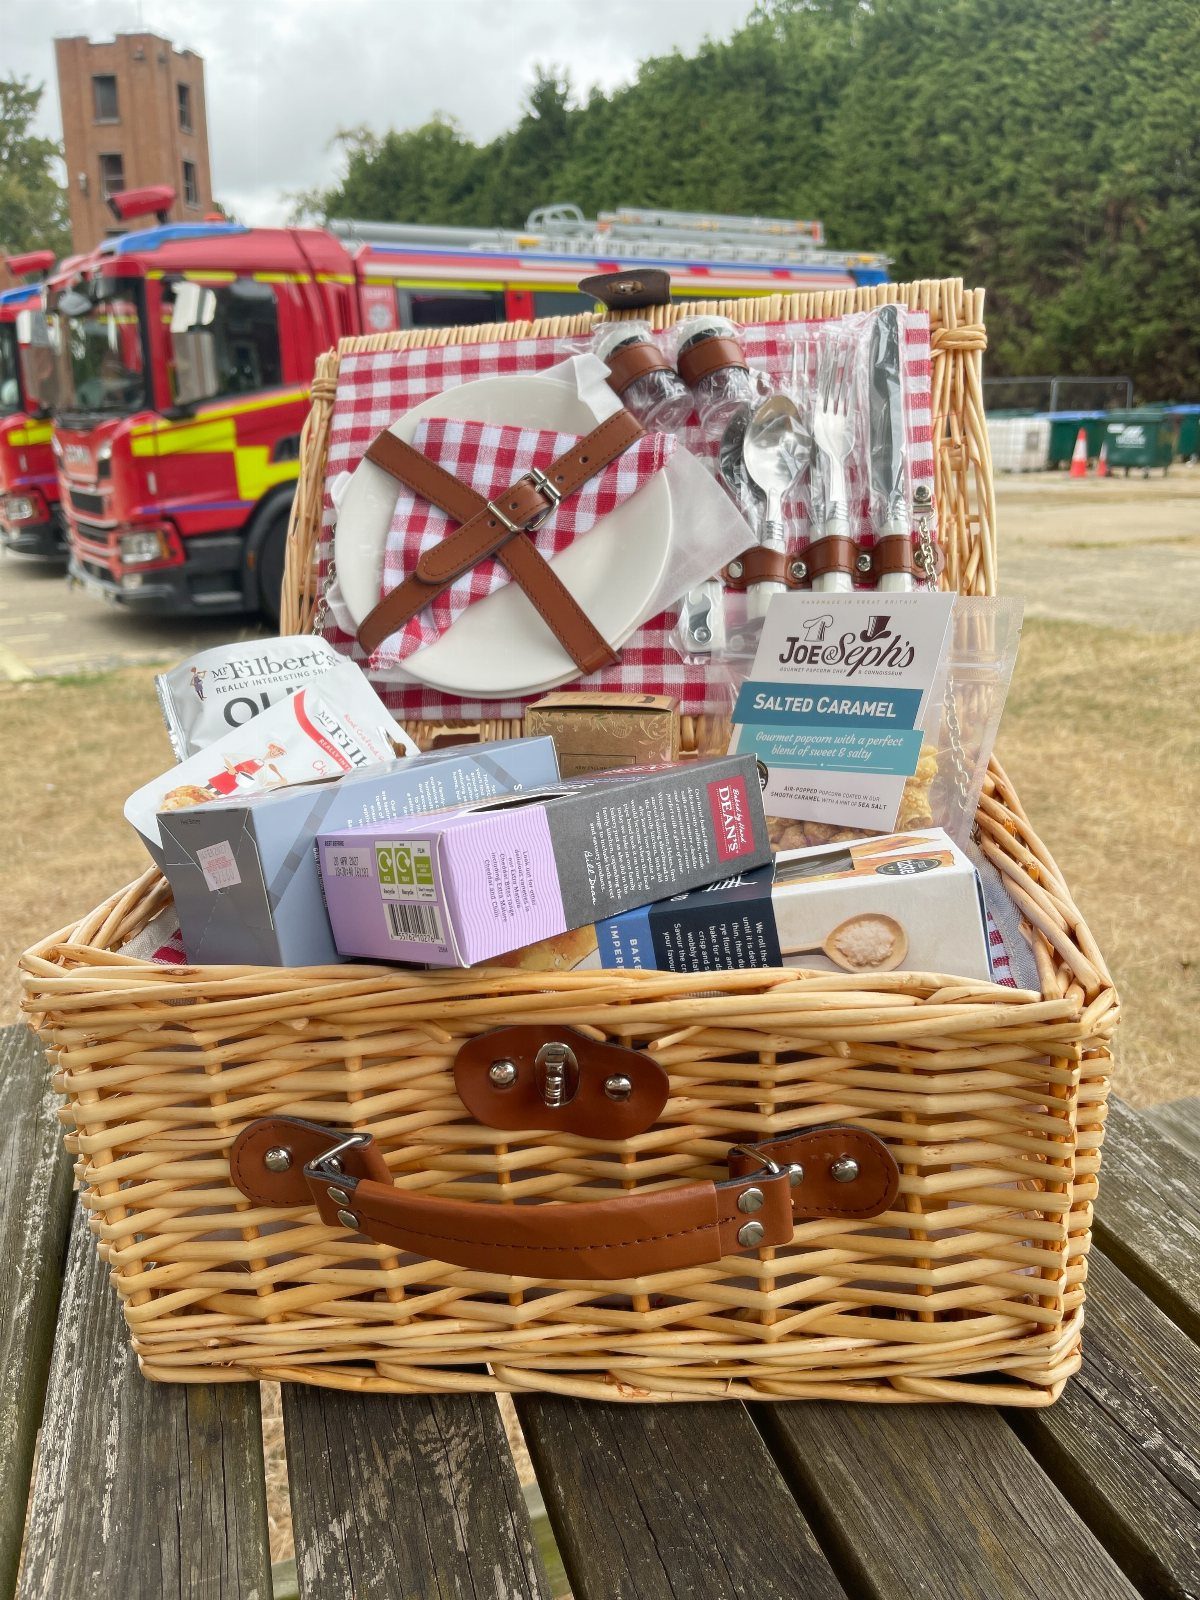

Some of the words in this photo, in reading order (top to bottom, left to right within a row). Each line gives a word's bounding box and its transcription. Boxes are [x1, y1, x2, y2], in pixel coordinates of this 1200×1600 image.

[225, 651, 340, 679] Filbert's
[216, 682, 249, 694] REALLY
[253, 670, 310, 686] INTERESTING
[753, 693, 813, 712] SALTED
[817, 697, 896, 718] CARAMEL
[756, 731, 794, 742] Gourmet
[793, 735, 832, 746] popcorn
[834, 733, 856, 744] with
[865, 735, 903, 748] perfect
[320, 740, 340, 760] REALLY
[772, 745, 795, 755] blend
[796, 746, 810, 757] of
[810, 749, 837, 757] sweet
[839, 748, 846, 757] &
[848, 748, 872, 761] salty
[719, 786, 738, 852] DEAN'S
[719, 924, 727, 935] rye
[743, 917, 751, 933] until
[756, 922, 763, 933] We
[663, 932, 671, 947] your
[674, 923, 682, 947] Savour
[709, 926, 717, 943] bake
[688, 932, 696, 957] wobbly
[702, 951, 710, 964] and
